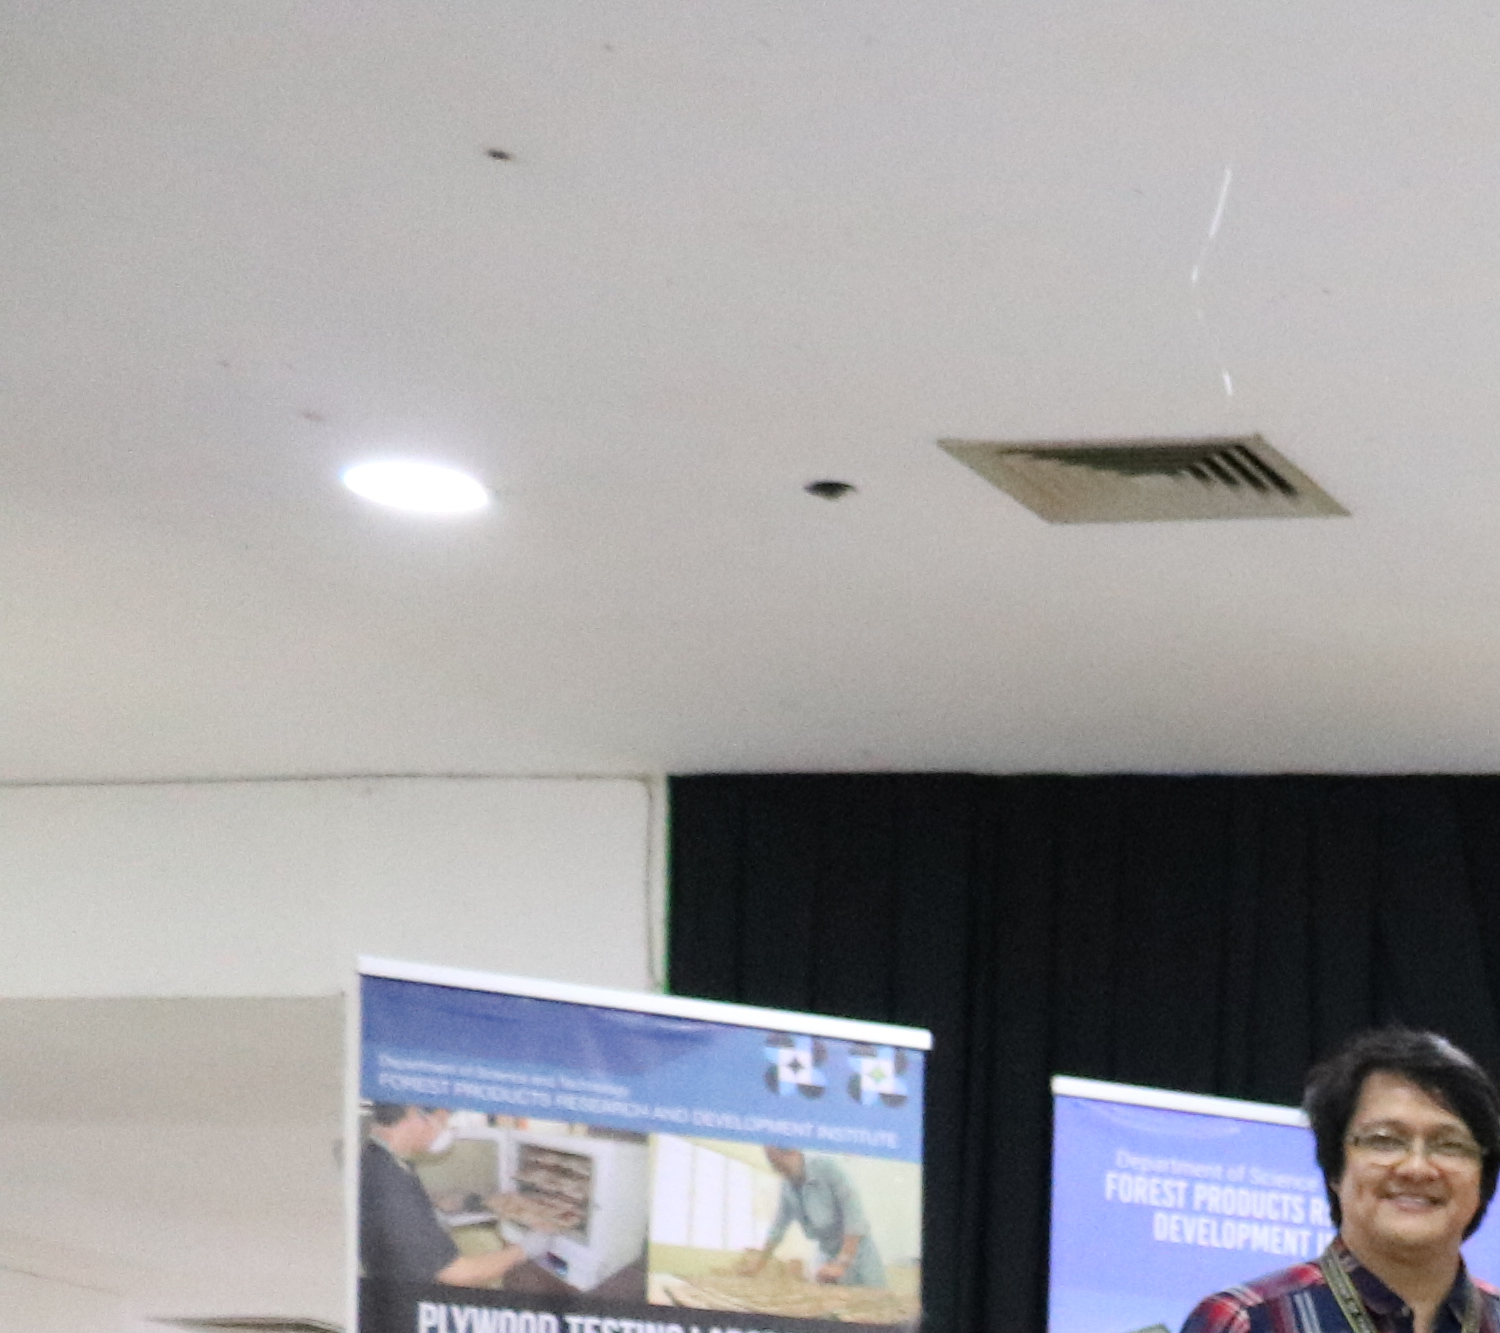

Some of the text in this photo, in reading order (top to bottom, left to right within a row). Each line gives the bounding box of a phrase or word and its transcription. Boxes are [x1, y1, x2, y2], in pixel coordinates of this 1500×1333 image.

[1105, 1171, 1188, 1209] FOREST
[1193, 1183, 1307, 1225] PRODUCTS
[1153, 1211, 1312, 1257] DEVELOPMENT
